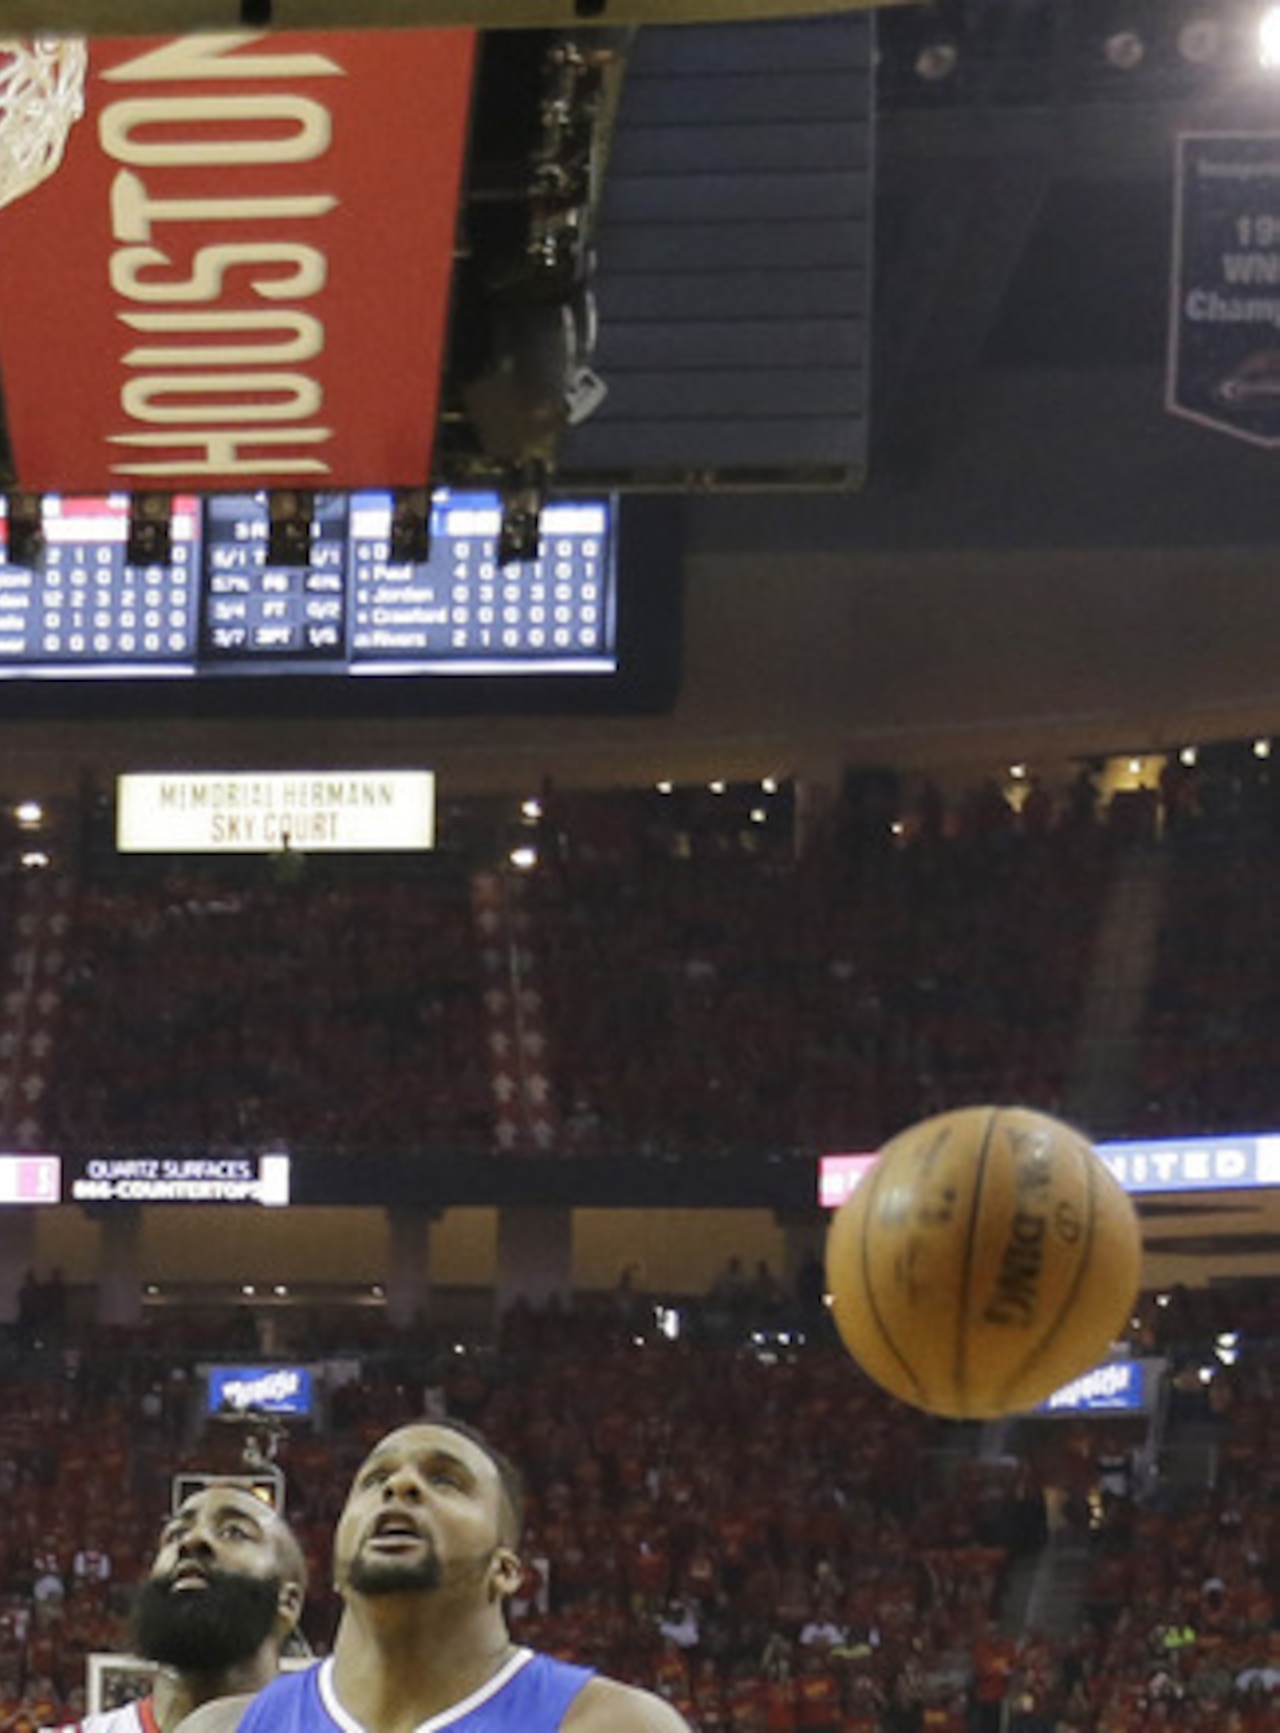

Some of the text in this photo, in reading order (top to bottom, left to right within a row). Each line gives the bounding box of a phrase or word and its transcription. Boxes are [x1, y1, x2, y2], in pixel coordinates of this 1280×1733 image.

[1235, 215, 1280, 247] 19
[98, 30, 347, 475] HOUSTON
[282, 780, 394, 808] HERMANN
[210, 811, 339, 843] SKY COURT
[87, 1159, 251, 1179] QUARTZ SURFACES
